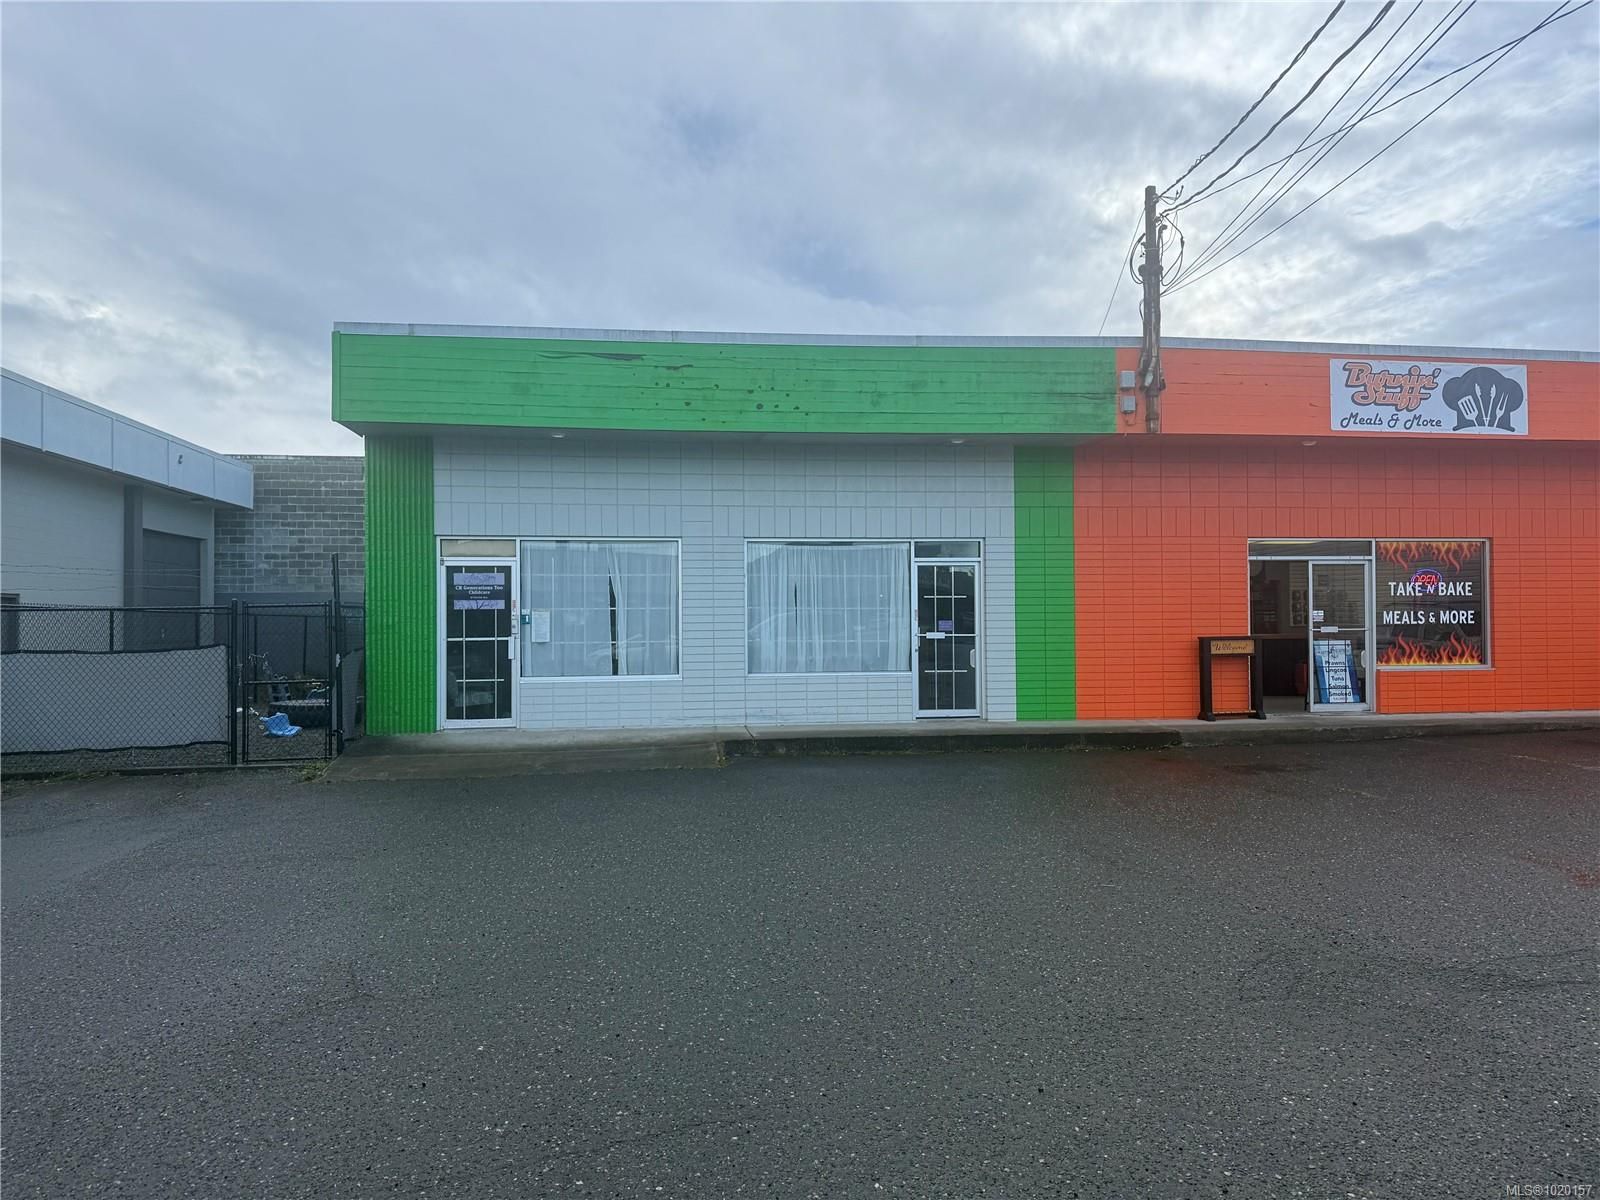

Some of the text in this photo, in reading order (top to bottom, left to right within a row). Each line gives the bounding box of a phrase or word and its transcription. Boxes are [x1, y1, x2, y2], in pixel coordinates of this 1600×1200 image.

[1351, 382, 1431, 412] Stuff
[1340, 412, 1442, 430] Meals & More
[1414, 574, 1440, 586] OPEN
[1388, 582, 1423, 596] TAKE
[1438, 582, 1473, 596] BAKE
[1383, 611, 1475, 625] MEALS & MORE
